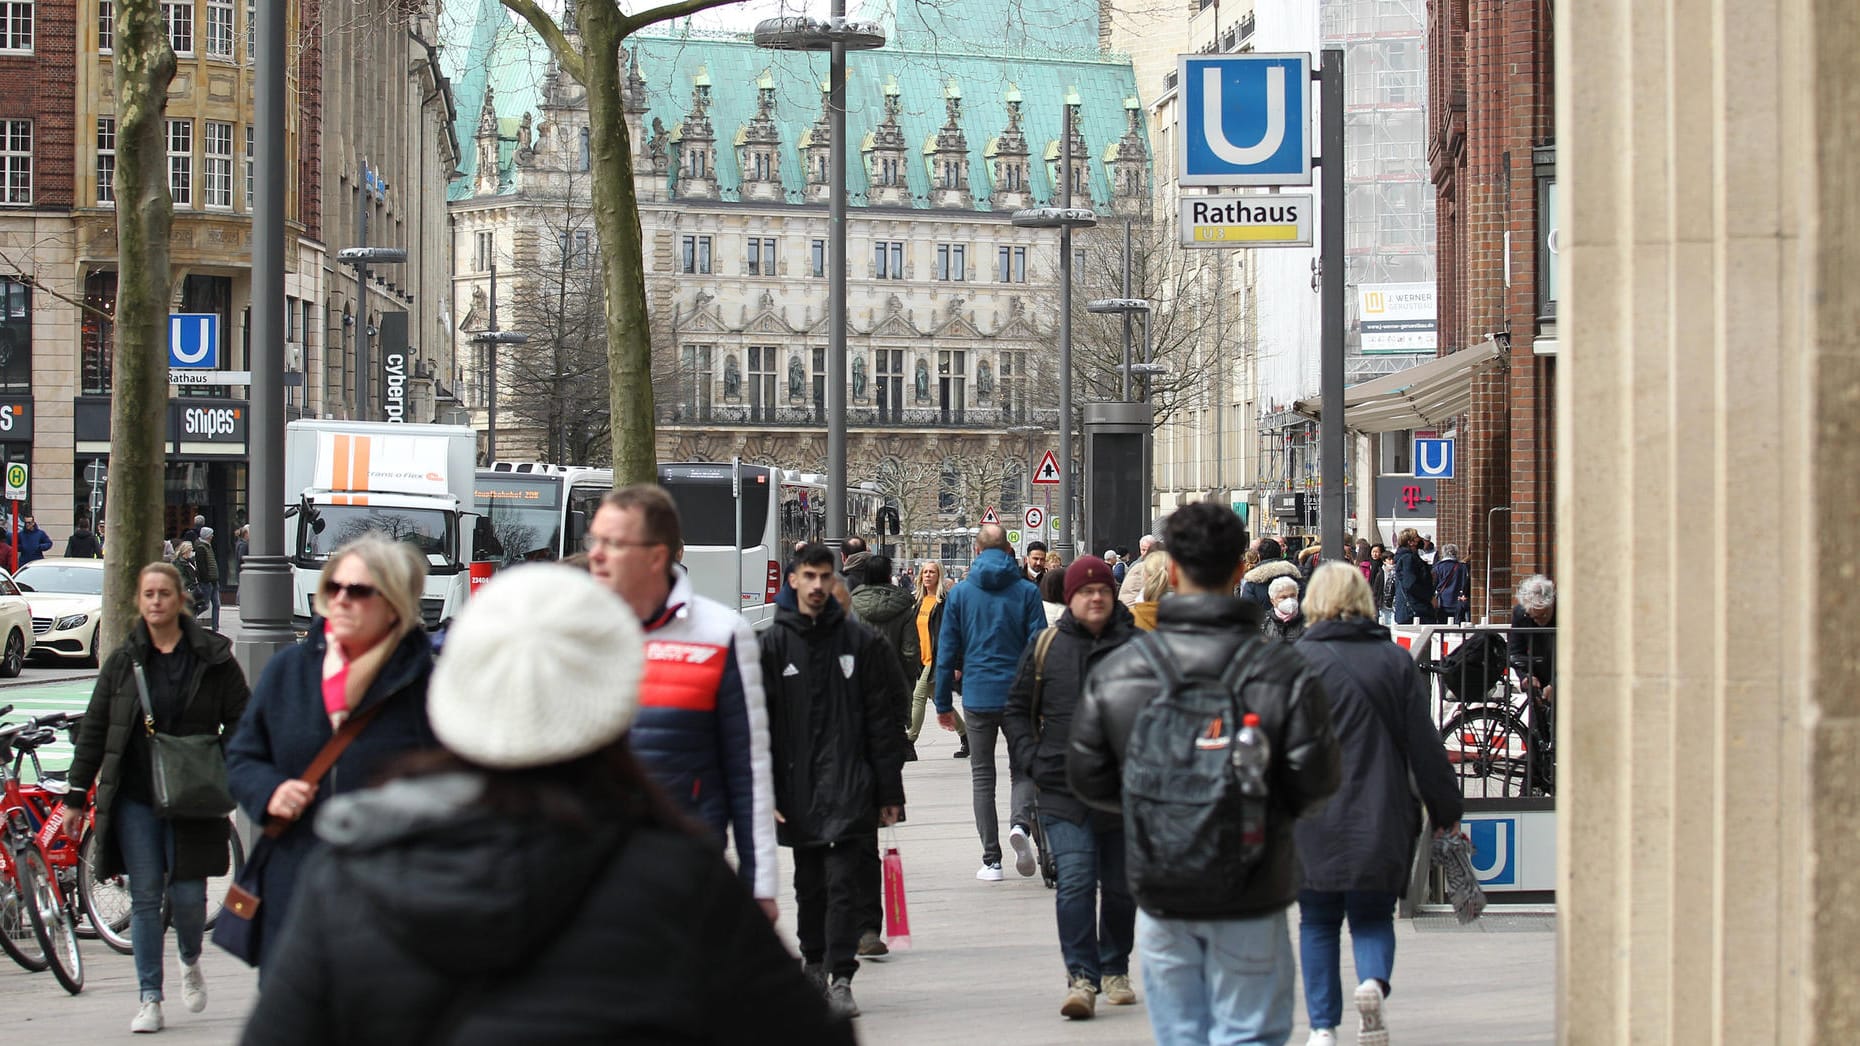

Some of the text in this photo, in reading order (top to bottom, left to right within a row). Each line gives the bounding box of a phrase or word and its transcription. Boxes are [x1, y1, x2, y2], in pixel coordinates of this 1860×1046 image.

[1203, 66, 1286, 165] U
[1193, 201, 1297, 223] Rathaus
[1396, 293, 1432, 302] WERNER
[172, 318, 209, 364] U
[185, 408, 235, 439] snipes
[1420, 442, 1448, 475] U
[1460, 822, 1507, 881] U
